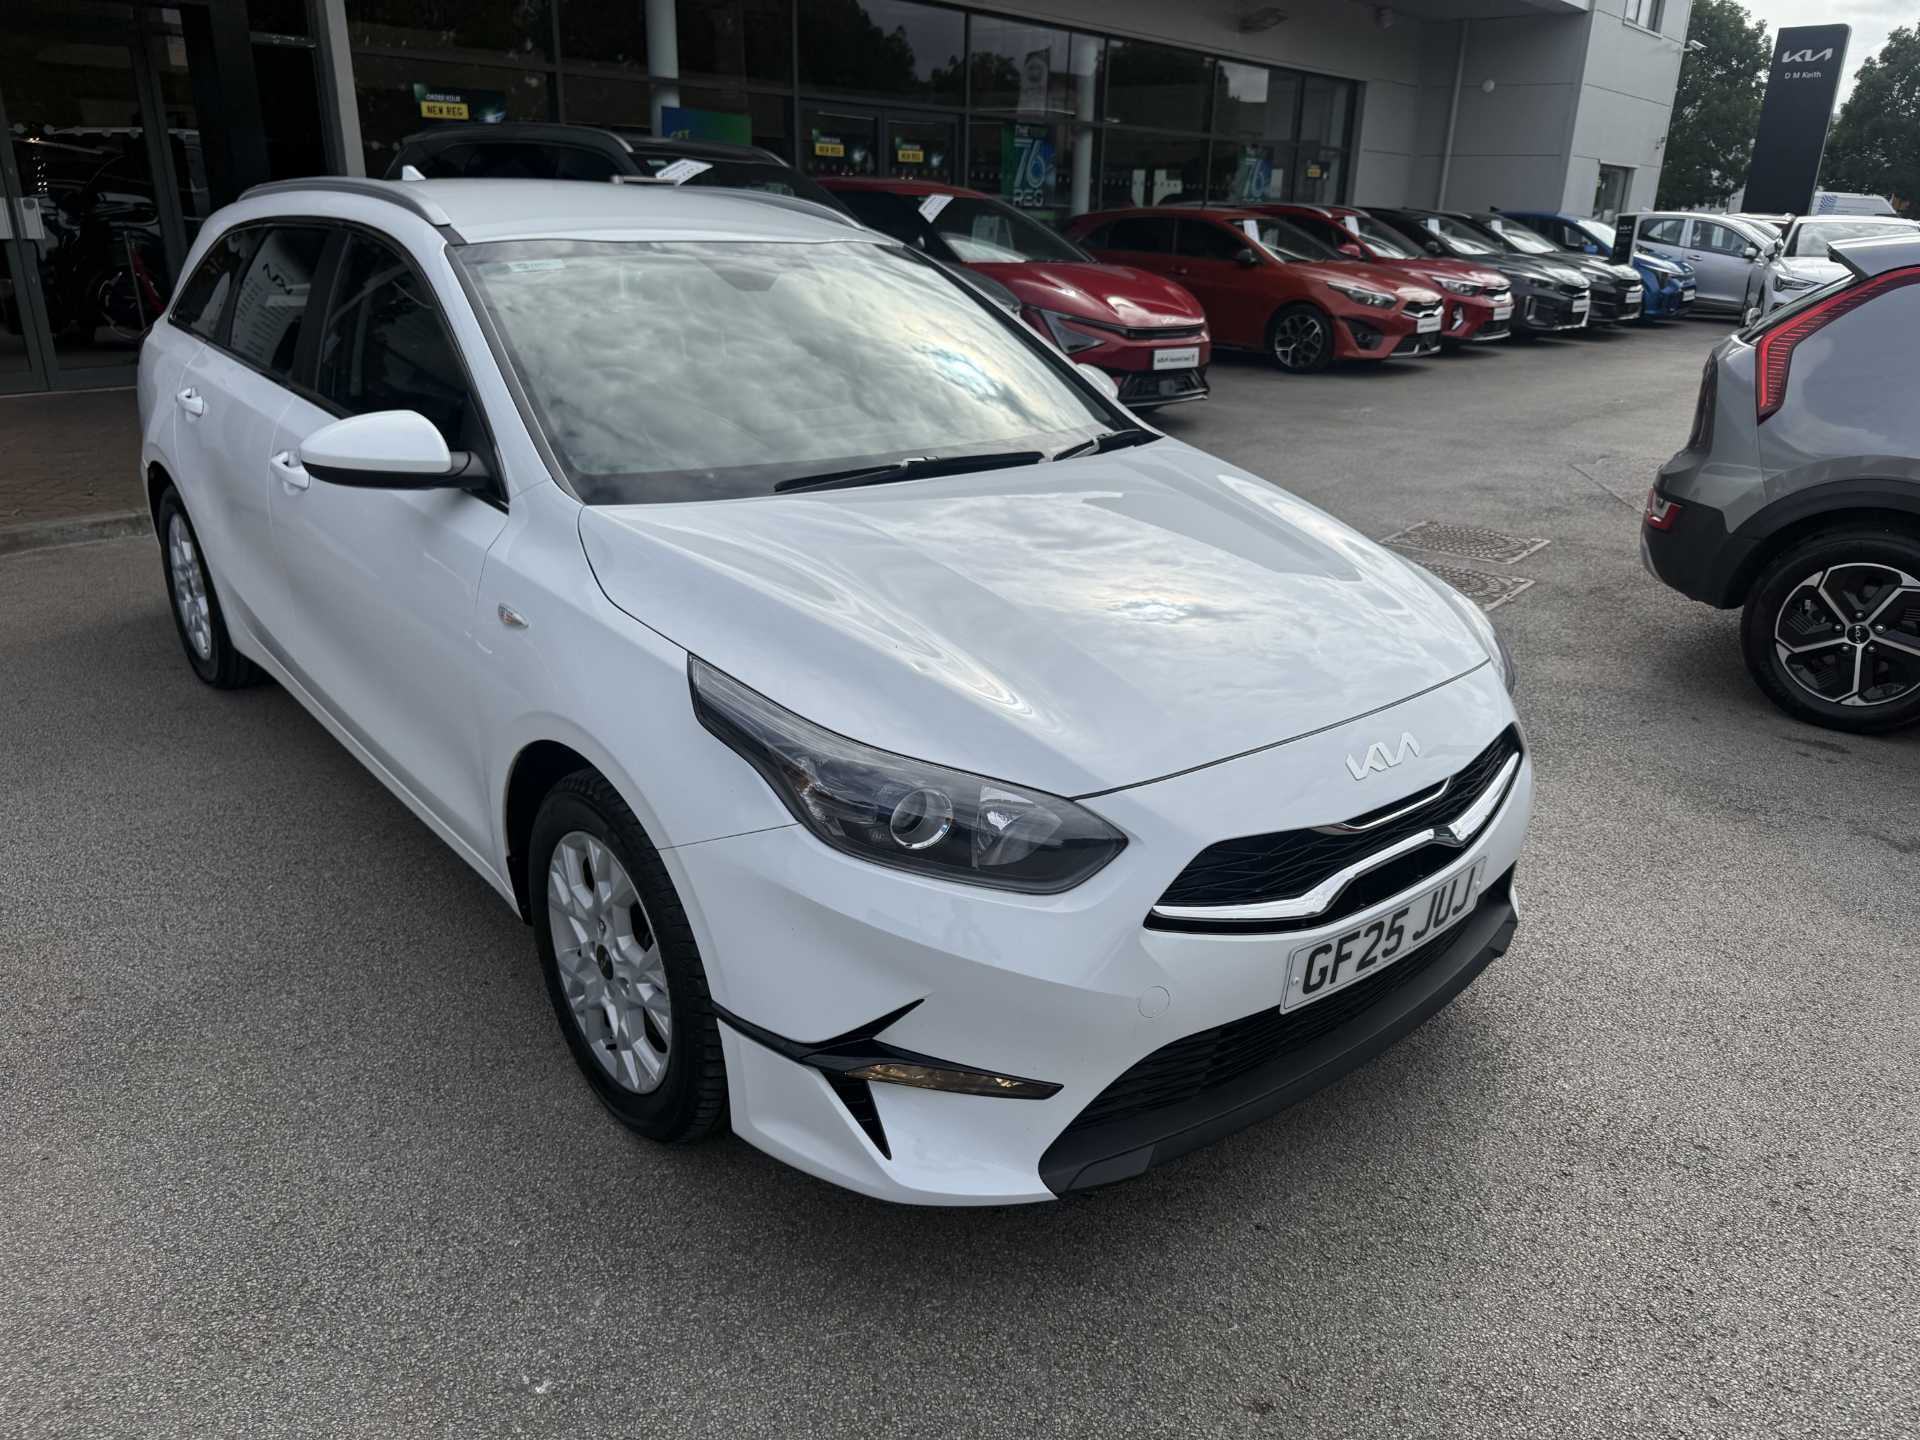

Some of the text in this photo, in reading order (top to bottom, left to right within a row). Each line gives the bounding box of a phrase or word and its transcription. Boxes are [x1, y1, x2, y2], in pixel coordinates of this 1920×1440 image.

[1782, 48, 1834, 63] KIA
[427, 105, 464, 117] NEW REG
[1013, 138, 1046, 188] 76
[1013, 189, 1044, 207] REG
[1345, 731, 1421, 781] KIA
[1302, 866, 1476, 995] GF25 JUJ
